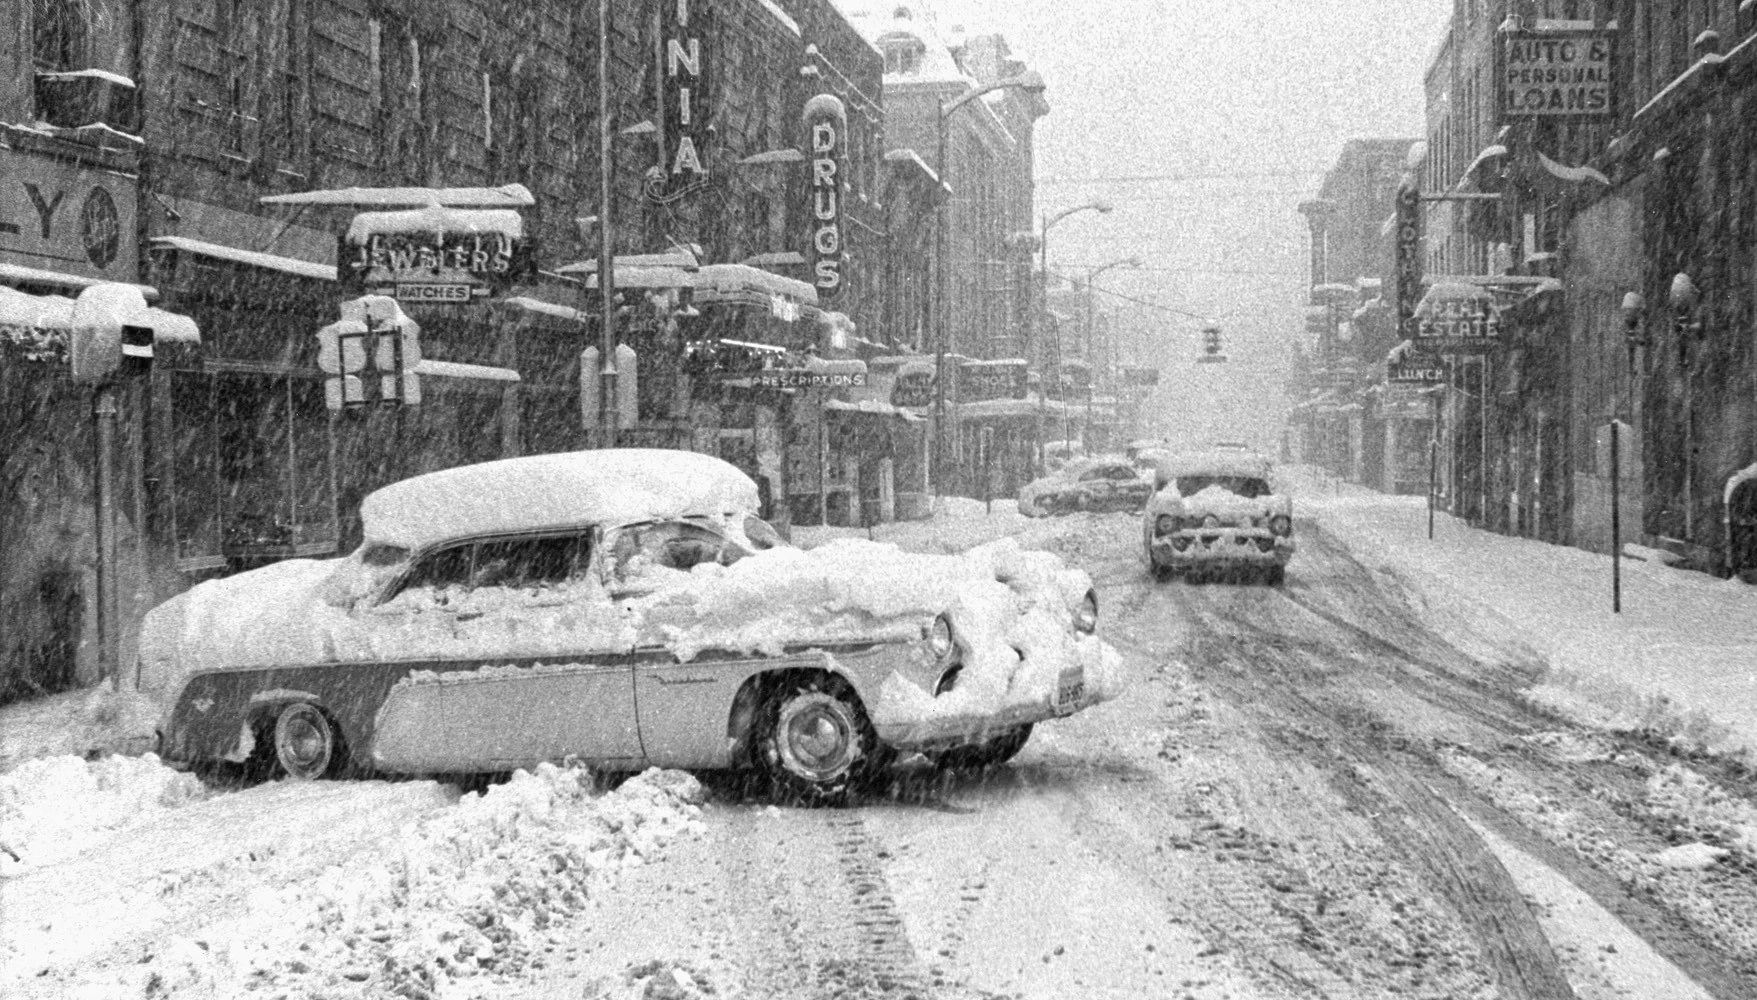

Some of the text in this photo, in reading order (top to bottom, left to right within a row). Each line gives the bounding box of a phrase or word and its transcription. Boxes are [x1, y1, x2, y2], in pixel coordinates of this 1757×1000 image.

[1509, 40, 1606, 63] AUTO &
[1508, 67, 1608, 84] PERSONAL
[1508, 87, 1606, 111] LOANS
[812, 121, 841, 290] DRUGS
[400, 285, 467, 300] WATCHES
[1418, 319, 1499, 337] ESTATE
[751, 373, 865, 388] PRESCRIPTIONS
[1398, 369, 1443, 380] LUNCH
